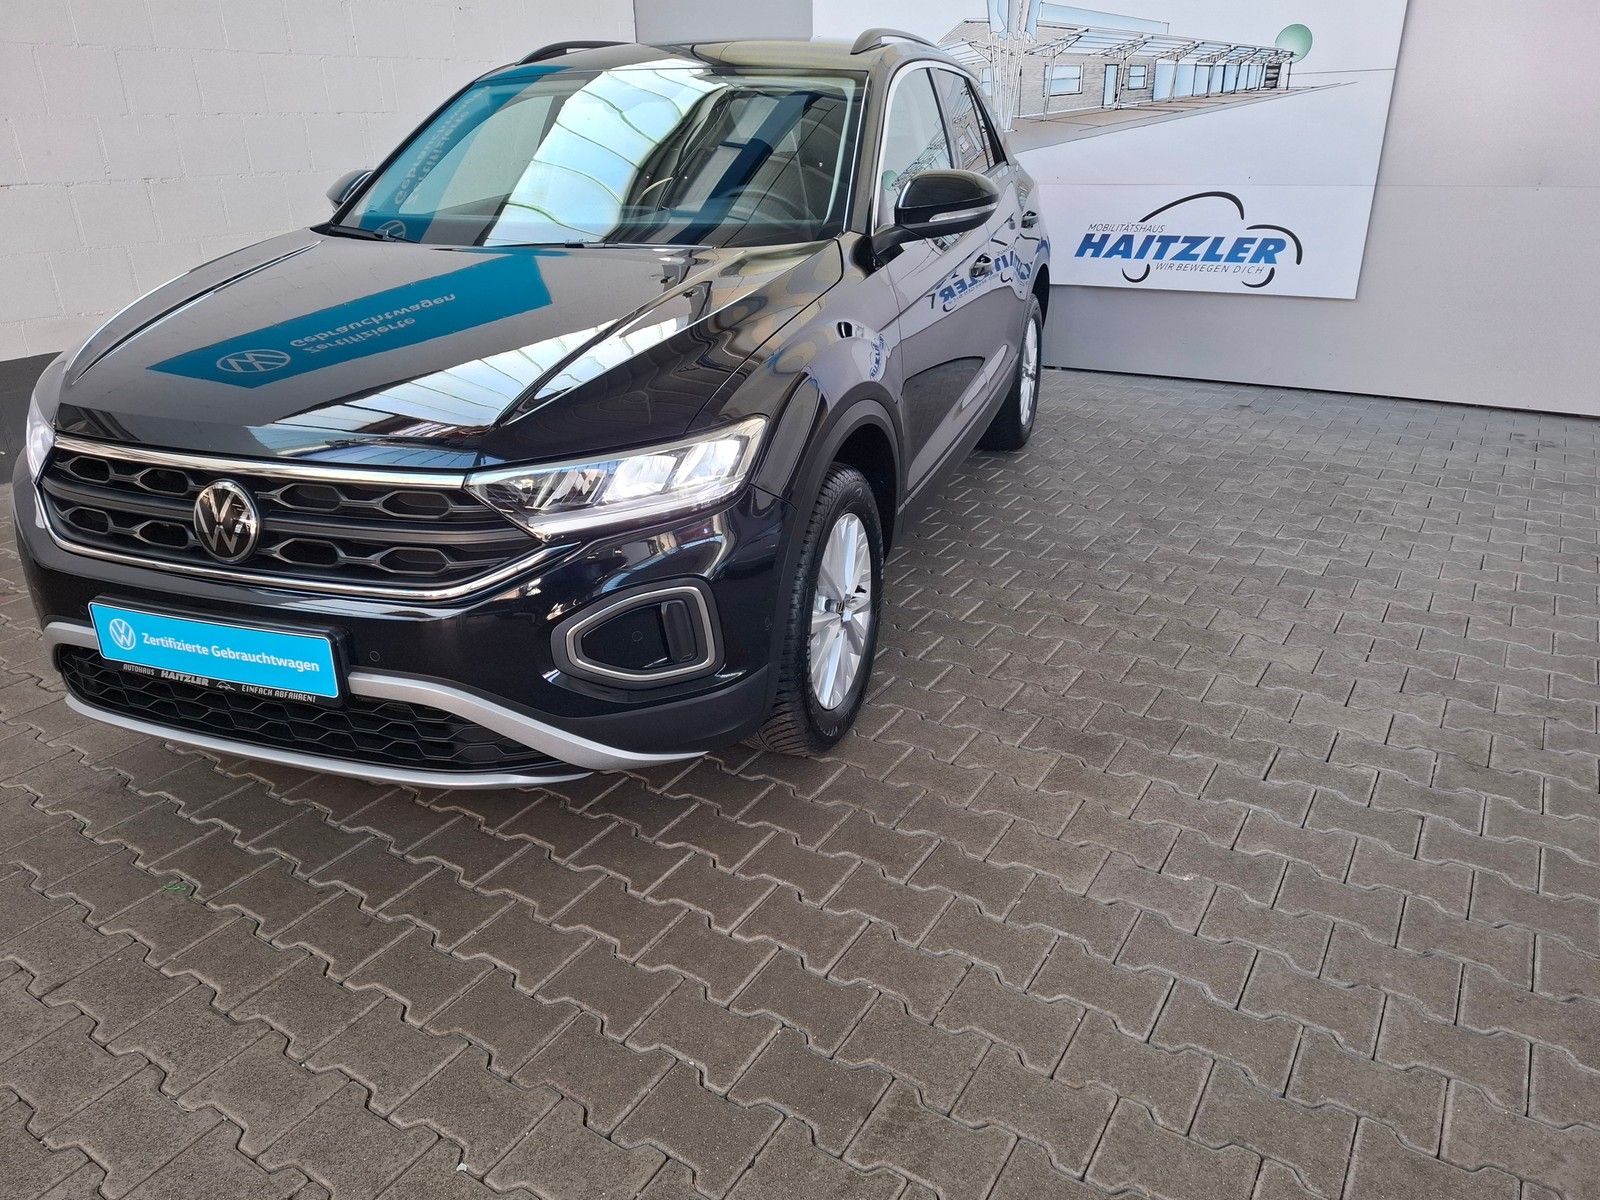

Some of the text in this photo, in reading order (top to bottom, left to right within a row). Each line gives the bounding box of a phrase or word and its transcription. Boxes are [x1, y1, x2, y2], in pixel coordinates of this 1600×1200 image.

[1088, 222, 1165, 233] MOBILITÄTSHAUS
[1074, 233, 1287, 265] HAITZLER
[1155, 262, 1265, 275] WIR BEWEGEN DICH
[142, 632, 320, 673] Zertifizierte Gebrauchtwagen
[123, 663, 209, 687] AUTOHAUS HAITZLER
[241, 684, 273, 697] EINFACH
